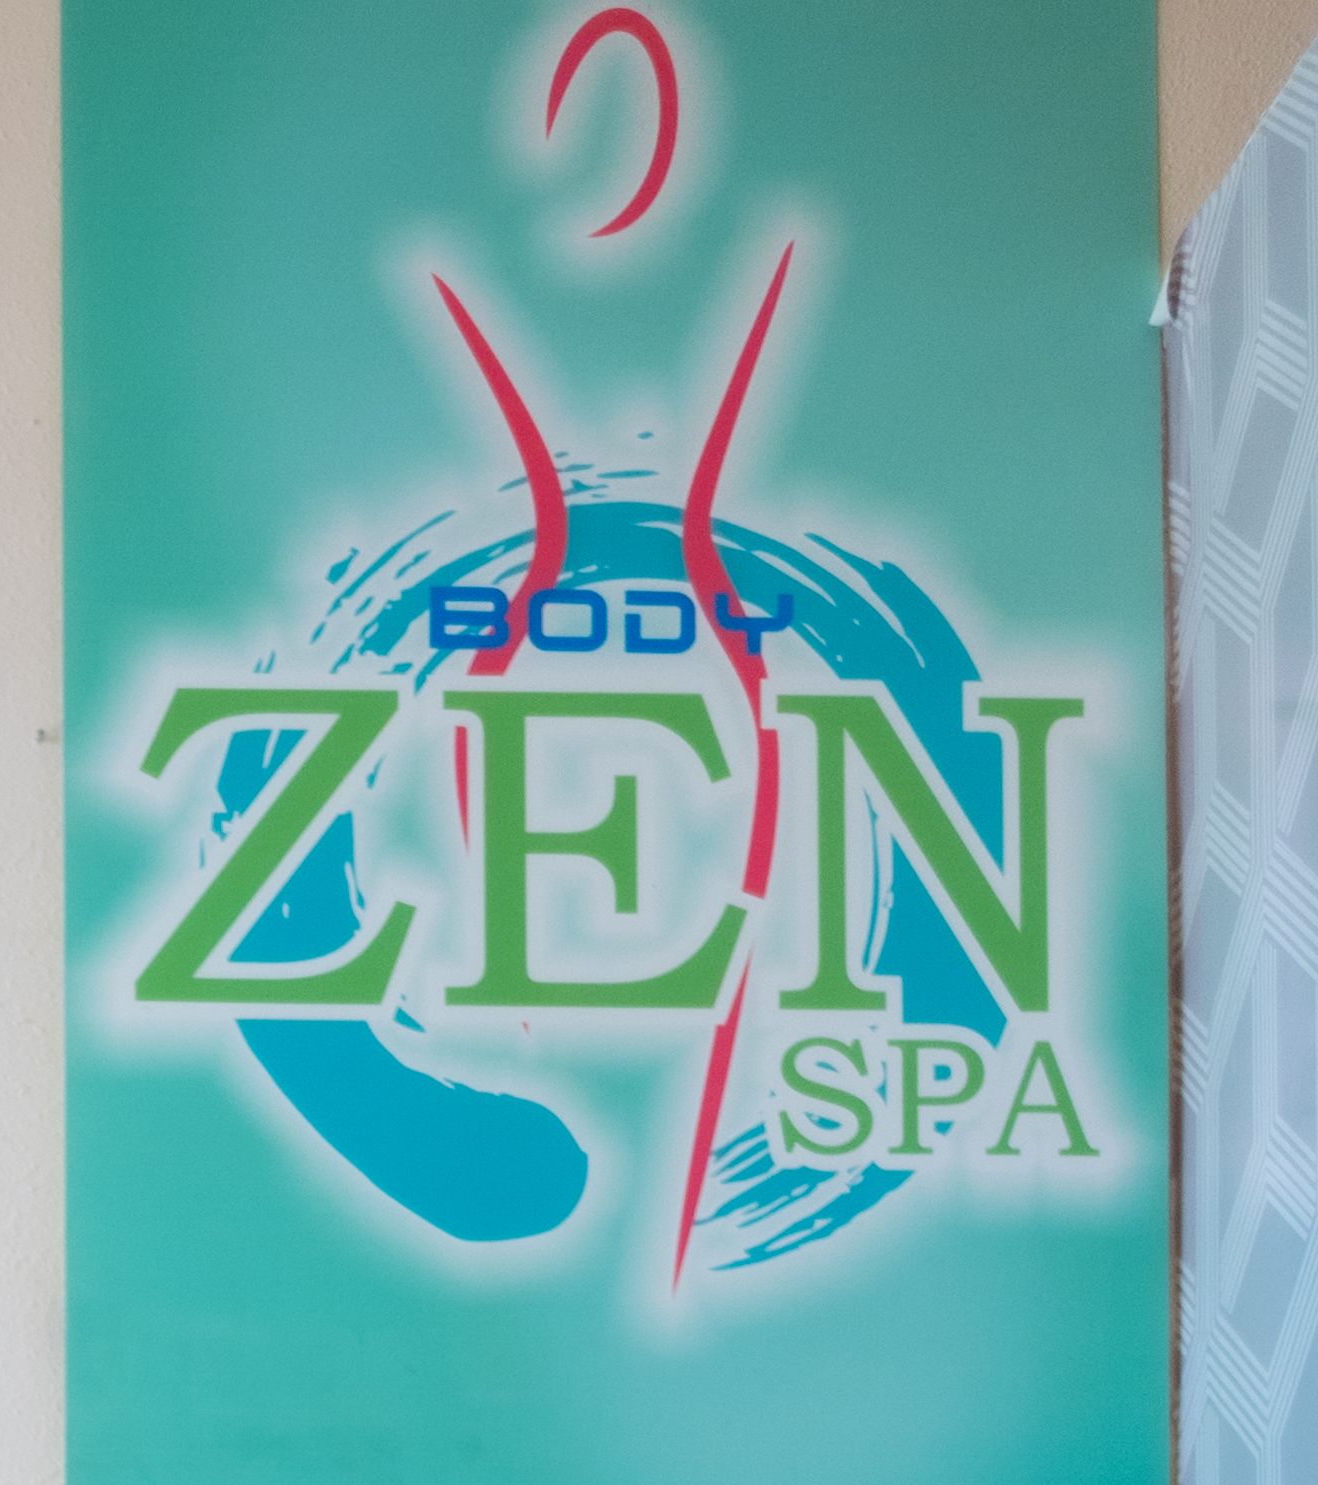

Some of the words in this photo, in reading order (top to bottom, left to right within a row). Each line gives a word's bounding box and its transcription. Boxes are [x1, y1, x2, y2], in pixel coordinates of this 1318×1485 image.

[429, 585, 794, 655] BODY
[134, 686, 1085, 1014] ZEN
[778, 1036, 1101, 1158] SPA
